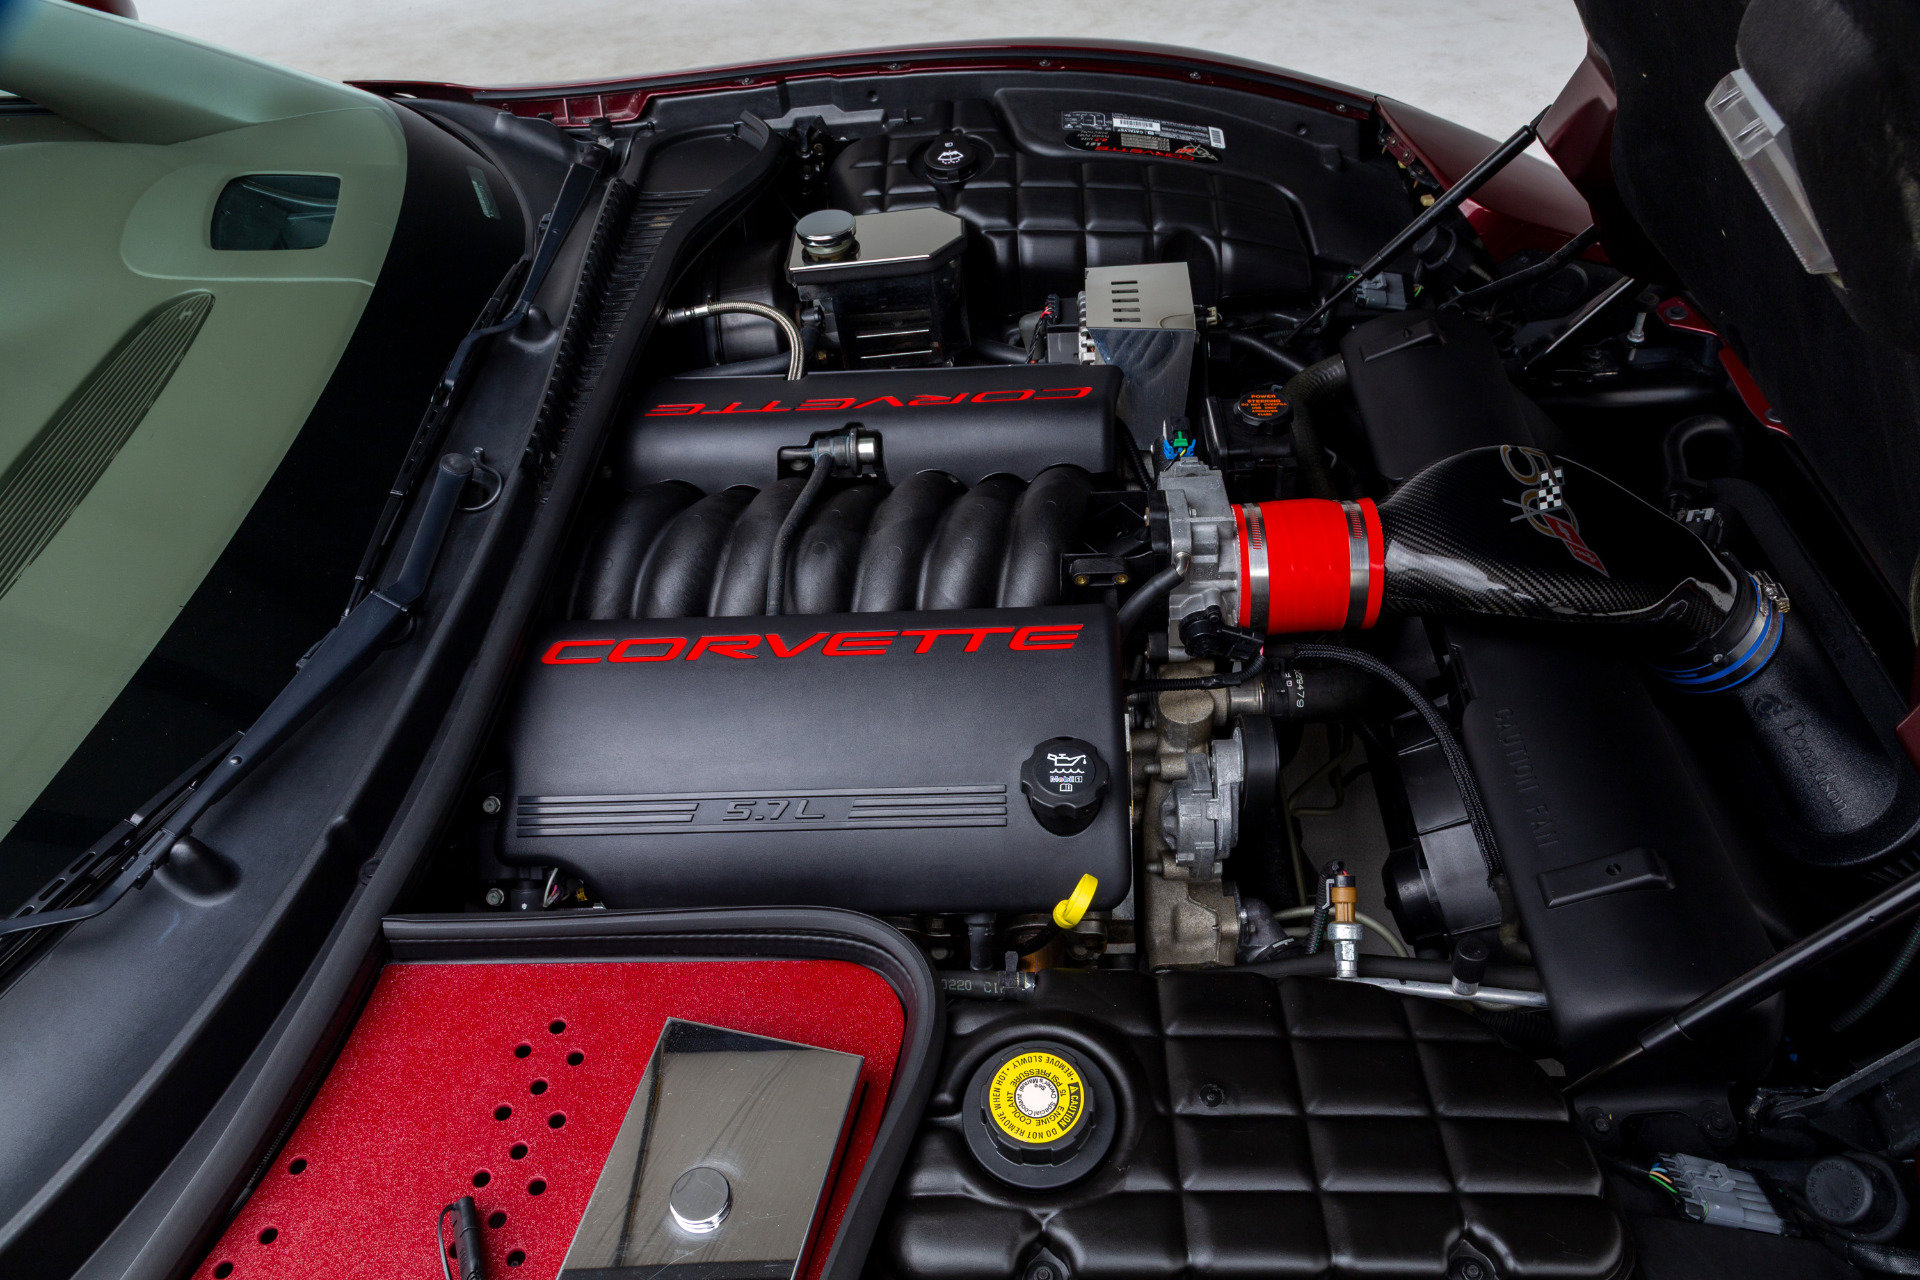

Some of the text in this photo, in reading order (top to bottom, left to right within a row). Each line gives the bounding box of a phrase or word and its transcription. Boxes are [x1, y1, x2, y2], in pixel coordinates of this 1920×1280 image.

[1095, 145, 1195, 161] CORVETTE
[644, 386, 1093, 417] CORVETTE
[541, 624, 1084, 665] CORVETTE
[1050, 775, 1074, 783] Mobil
[722, 799, 825, 821] 5.7L
[1526, 805, 1559, 848] FAN
[1012, 1055, 1074, 1078] REMOVE SLOWLY
[1010, 1069, 1067, 1097] 15 PSI PRESSURE
[1019, 1078, 1039, 1092] Manual
[1034, 1083, 1046, 1091] See
[993, 1071, 1058, 1140] DO NOT REMOVE WHEN HOT
[1007, 1091, 1065, 1127] ENGINE COOLANT
[1017, 1093, 1056, 1117] Special Coolant
[1061, 1095, 1079, 1128] CAUTION
